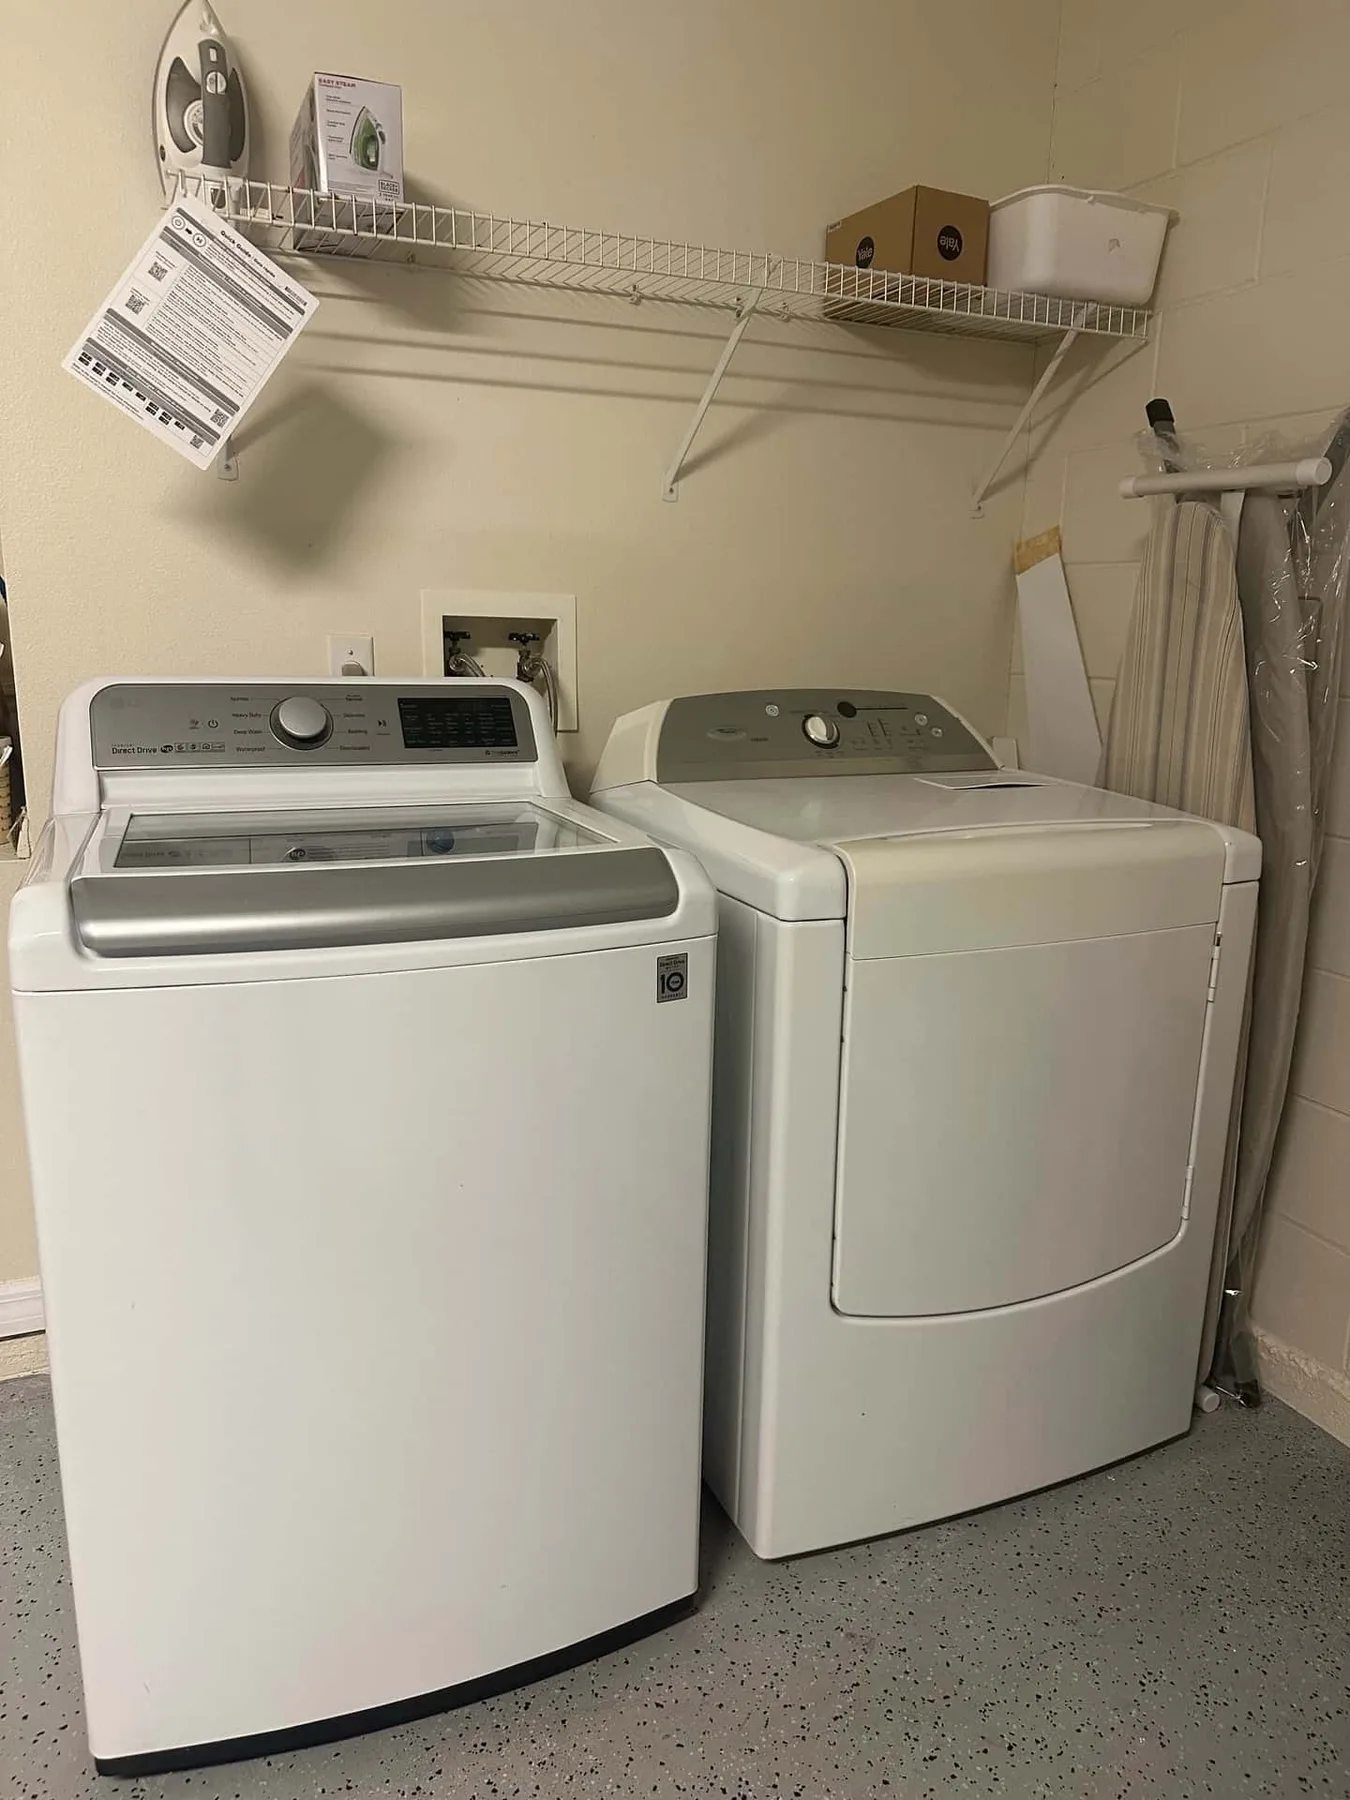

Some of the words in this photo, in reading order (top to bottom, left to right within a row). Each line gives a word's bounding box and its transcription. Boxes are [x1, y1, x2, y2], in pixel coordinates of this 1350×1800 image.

[336, 80, 356, 88] STEAM
[221, 230, 235, 244] Quick
[236, 243, 251, 257] Guide
[939, 235, 960, 253] Yale
[857, 246, 873, 262] Yale
[136, 746, 158, 754] Drive
